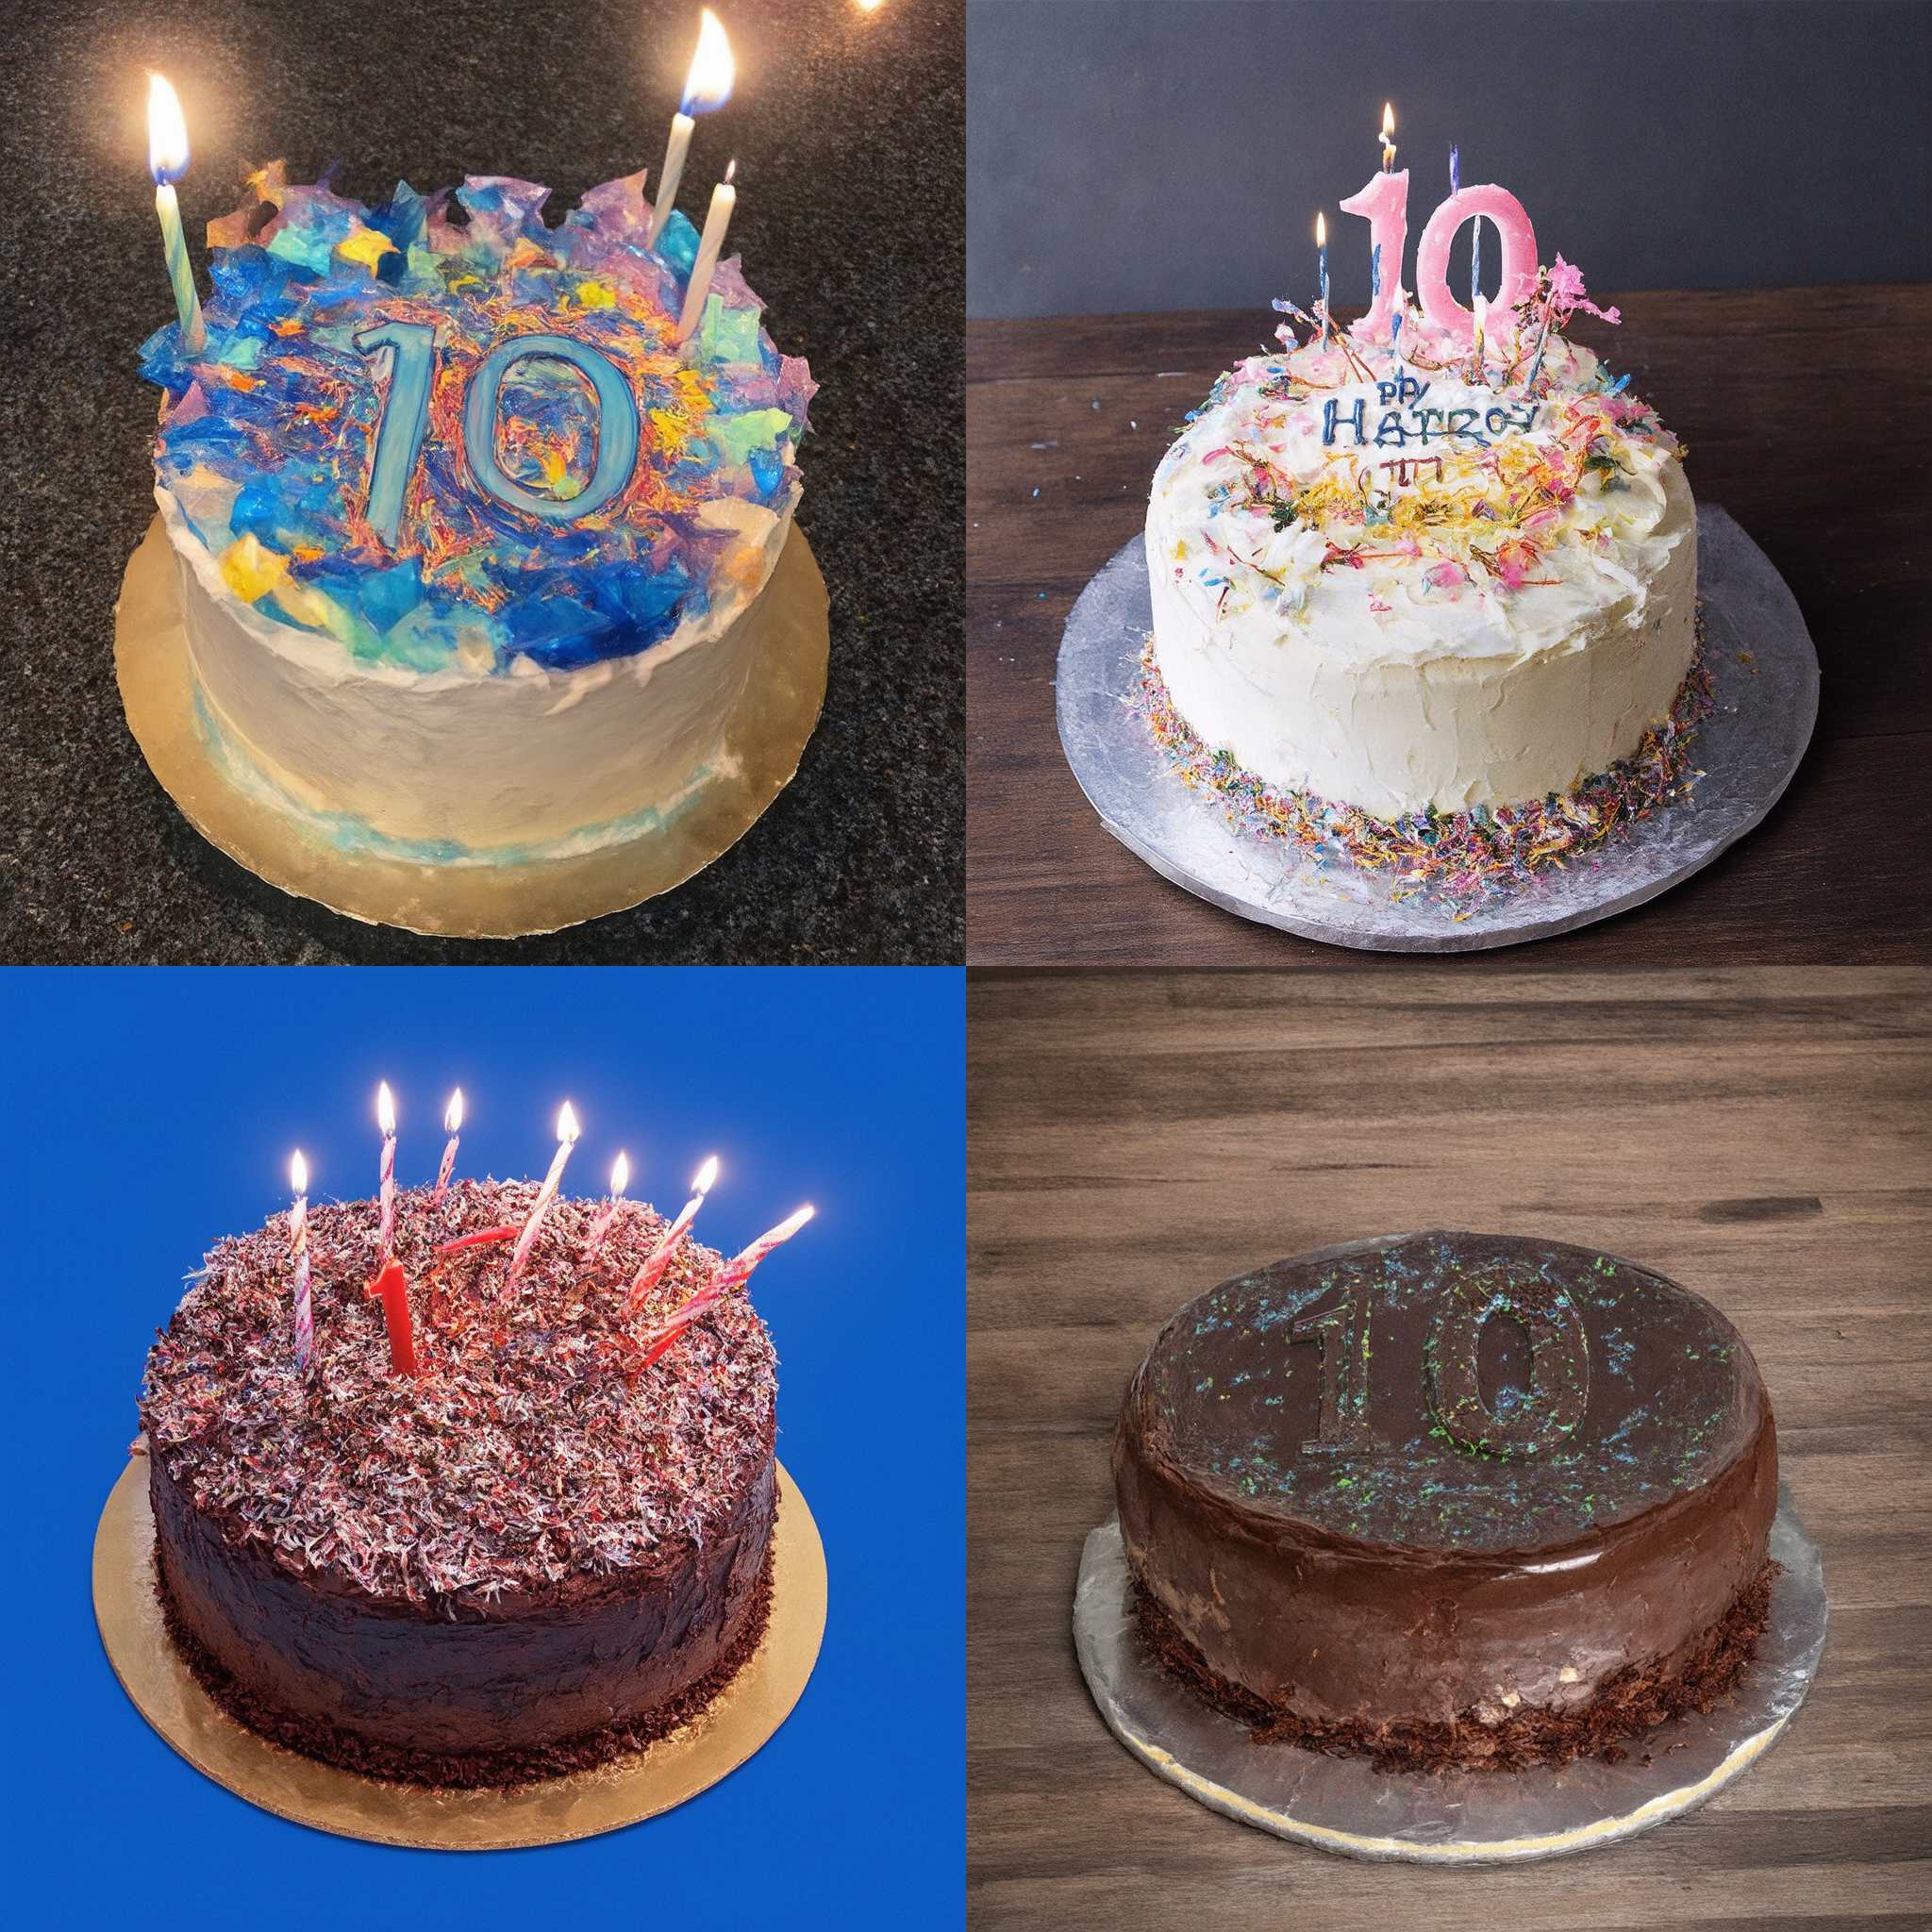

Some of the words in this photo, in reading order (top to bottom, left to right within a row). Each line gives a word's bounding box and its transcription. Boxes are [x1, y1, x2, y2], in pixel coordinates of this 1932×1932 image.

[1339, 168, 1539, 333] 10
[352, 321, 640, 550] 10
[1283, 1264, 1591, 1459] 10
